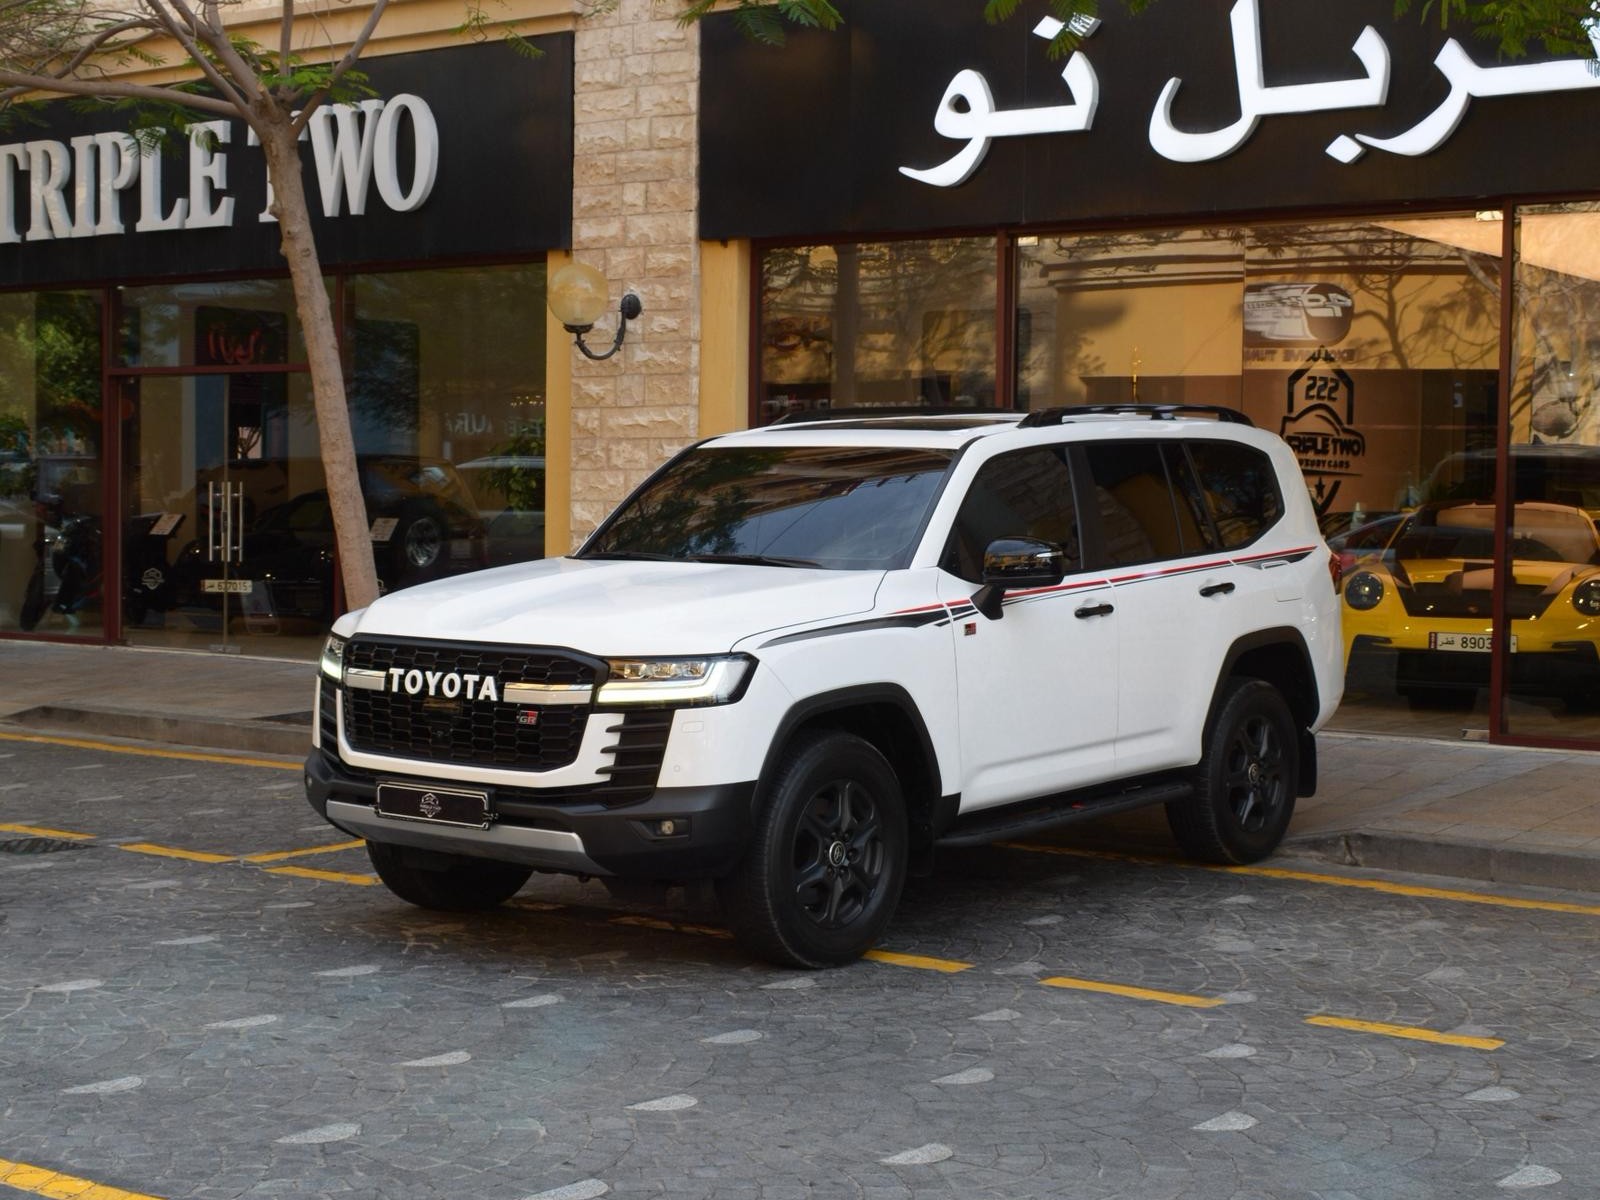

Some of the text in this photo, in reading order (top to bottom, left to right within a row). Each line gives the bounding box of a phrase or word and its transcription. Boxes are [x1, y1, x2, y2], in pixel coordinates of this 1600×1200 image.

[1305, 375, 1340, 401] 222
[1331, 438, 1361, 457] TWO
[389, 667, 498, 701] TOYOTA
